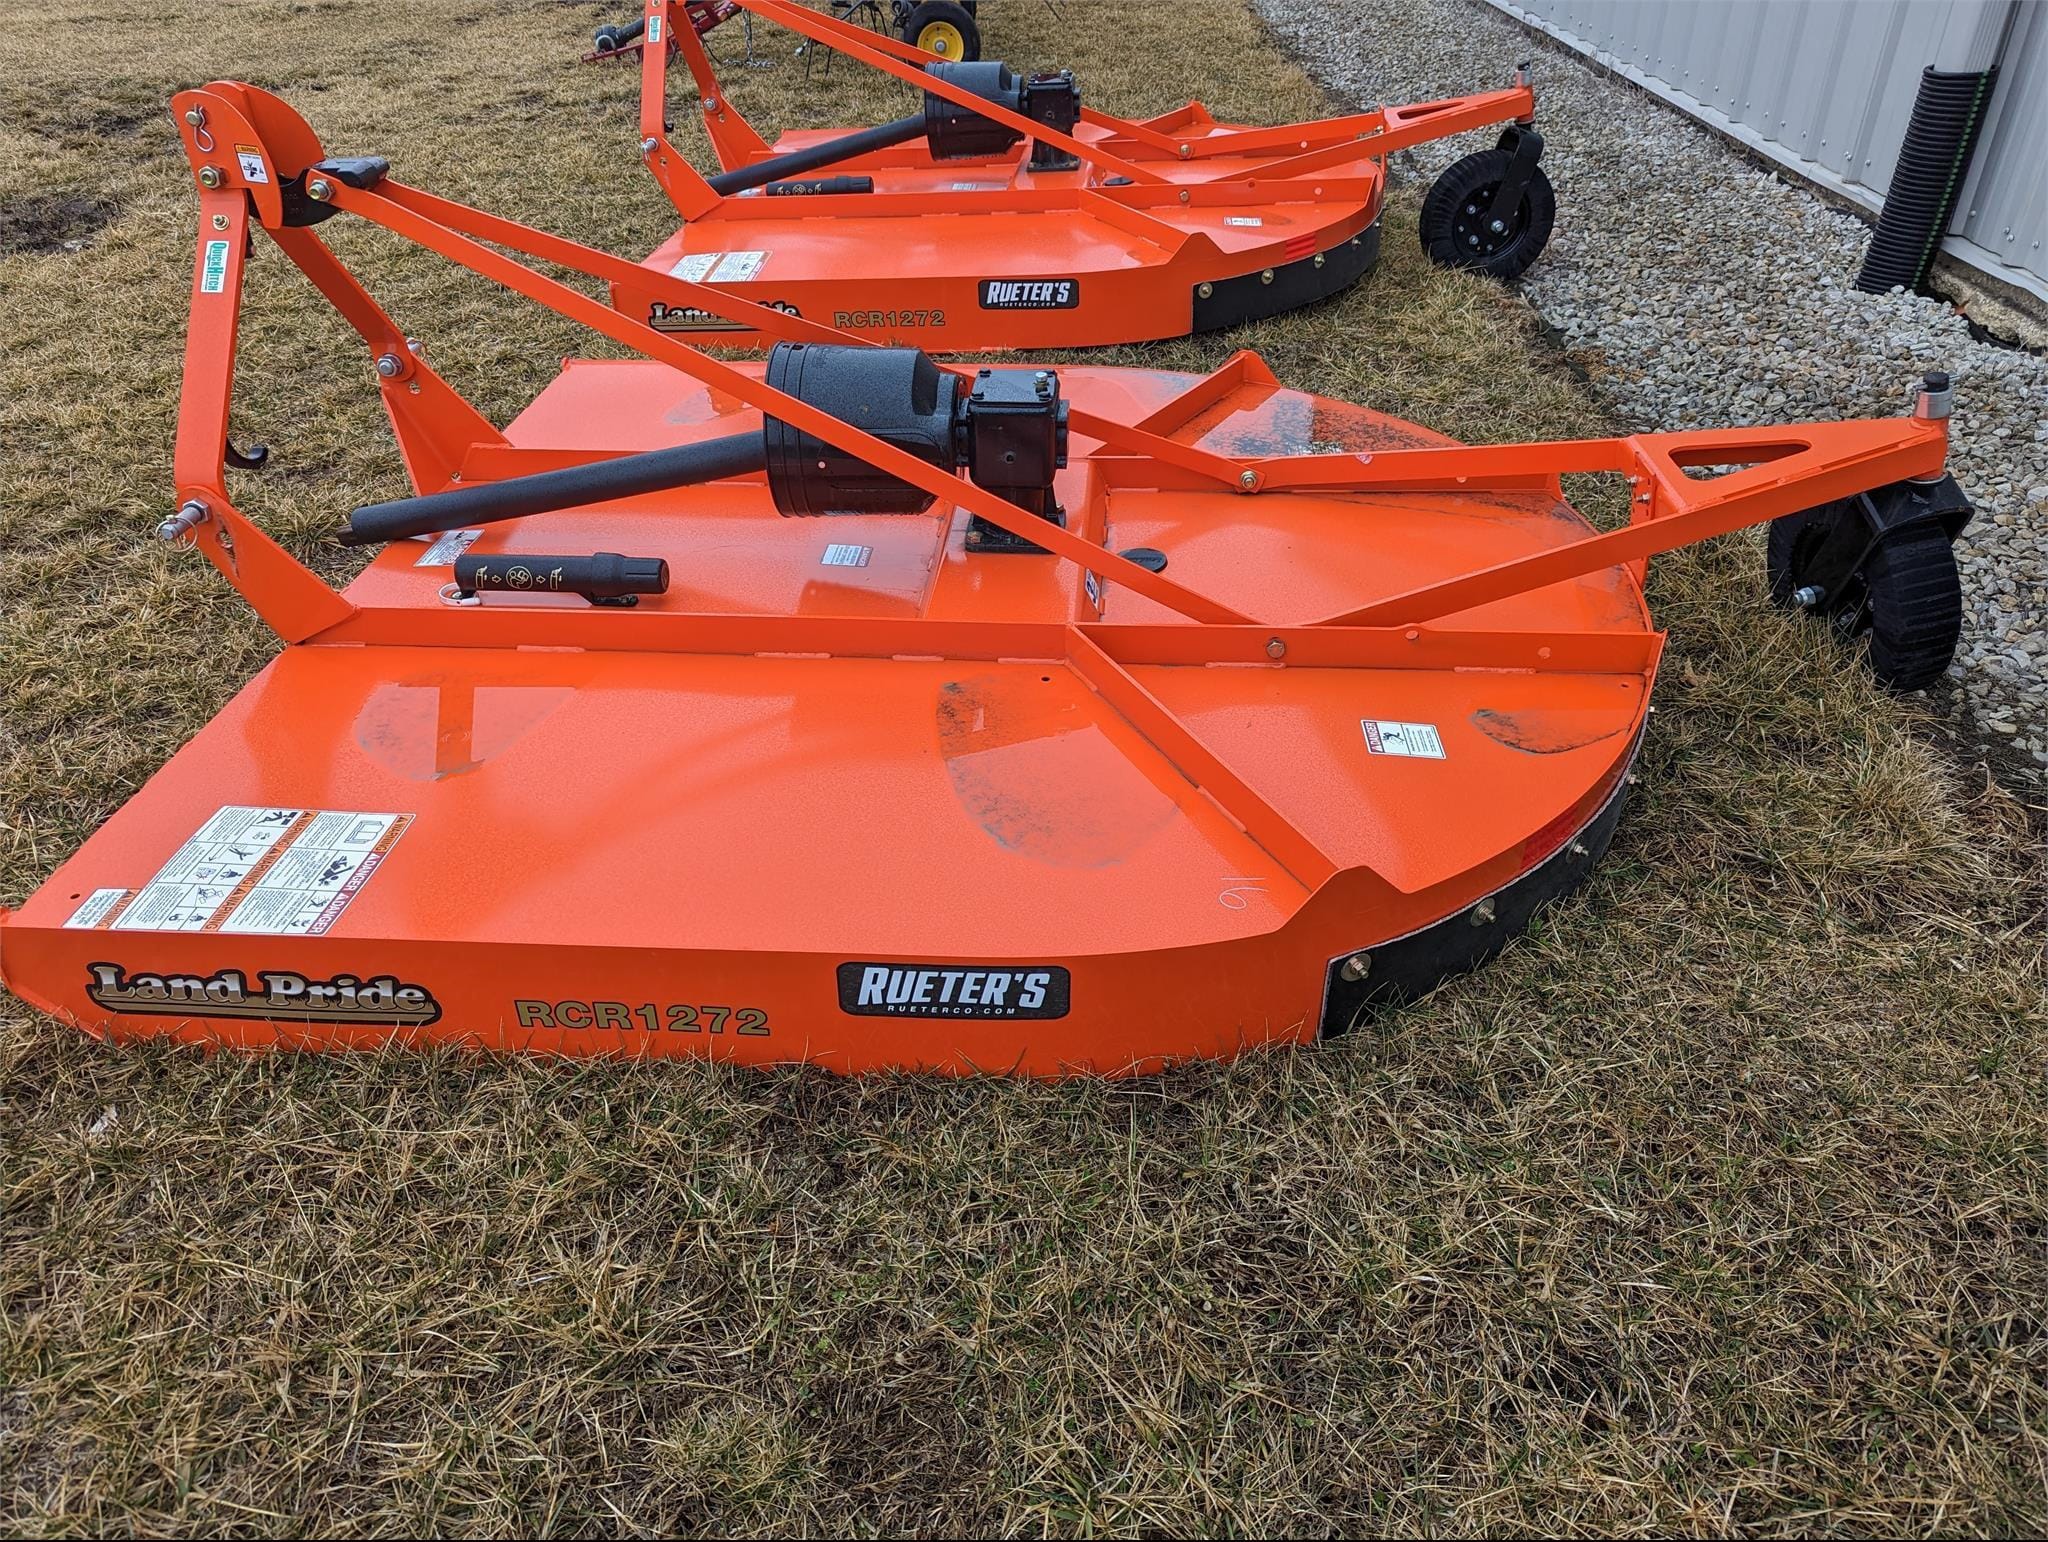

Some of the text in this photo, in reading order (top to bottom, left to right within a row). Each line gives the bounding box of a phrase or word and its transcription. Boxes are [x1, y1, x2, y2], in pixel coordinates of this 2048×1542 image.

[987, 282, 1070, 304] RUETER'S
[834, 310, 945, 328] RCR1272
[278, 821, 307, 846] WARNING
[376, 822, 404, 852] WARNING
[243, 854, 274, 885] WARNING
[345, 859, 376, 891] DANGER
[206, 895, 237, 929] WARNING
[310, 901, 343, 934] DANGER
[92, 965, 426, 1012] Land Pride
[858, 967, 1050, 1008] RUETER'S
[514, 1000, 770, 1036] RCR1272
[887, 1005, 1016, 1016] RUETERCO.COM
